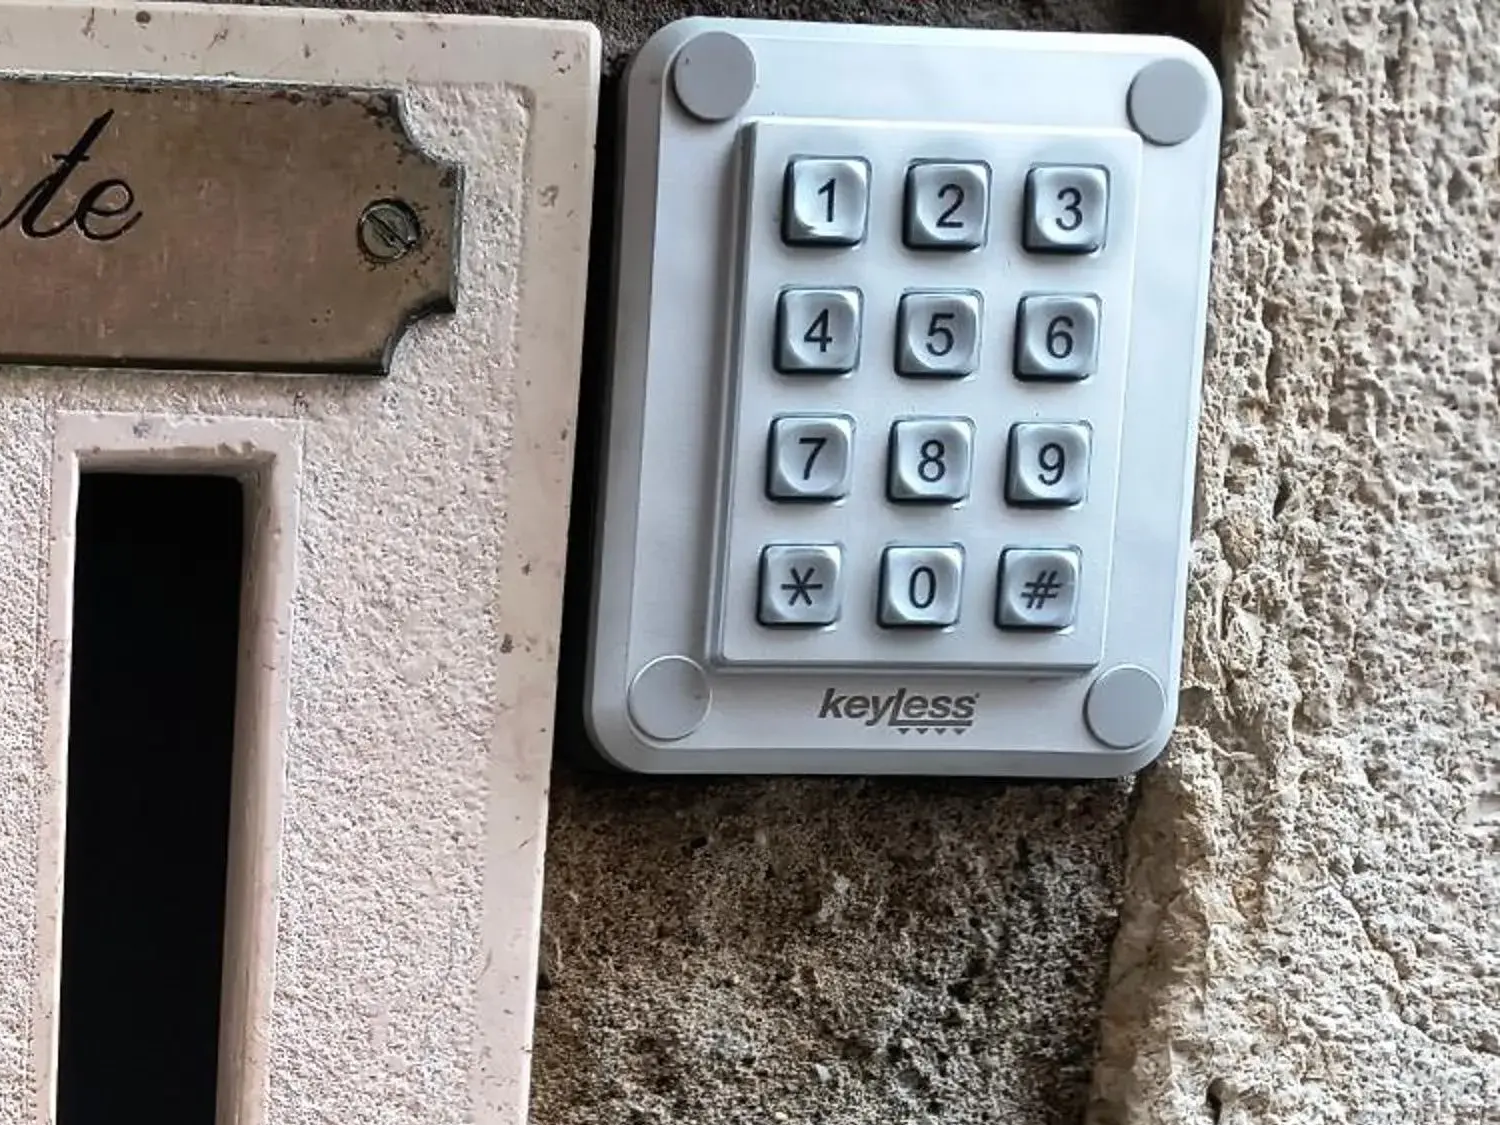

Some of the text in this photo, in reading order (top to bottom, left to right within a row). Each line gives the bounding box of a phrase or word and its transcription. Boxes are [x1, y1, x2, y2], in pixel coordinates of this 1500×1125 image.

[815, 178, 1084, 232] 1 2 3
[803, 309, 1074, 360] 4 5 6
[798, 437, 1066, 487] 7 8 9
[908, 565, 938, 610] 0
[1019, 570, 1064, 609] #
[818, 687, 975, 728] keyless
